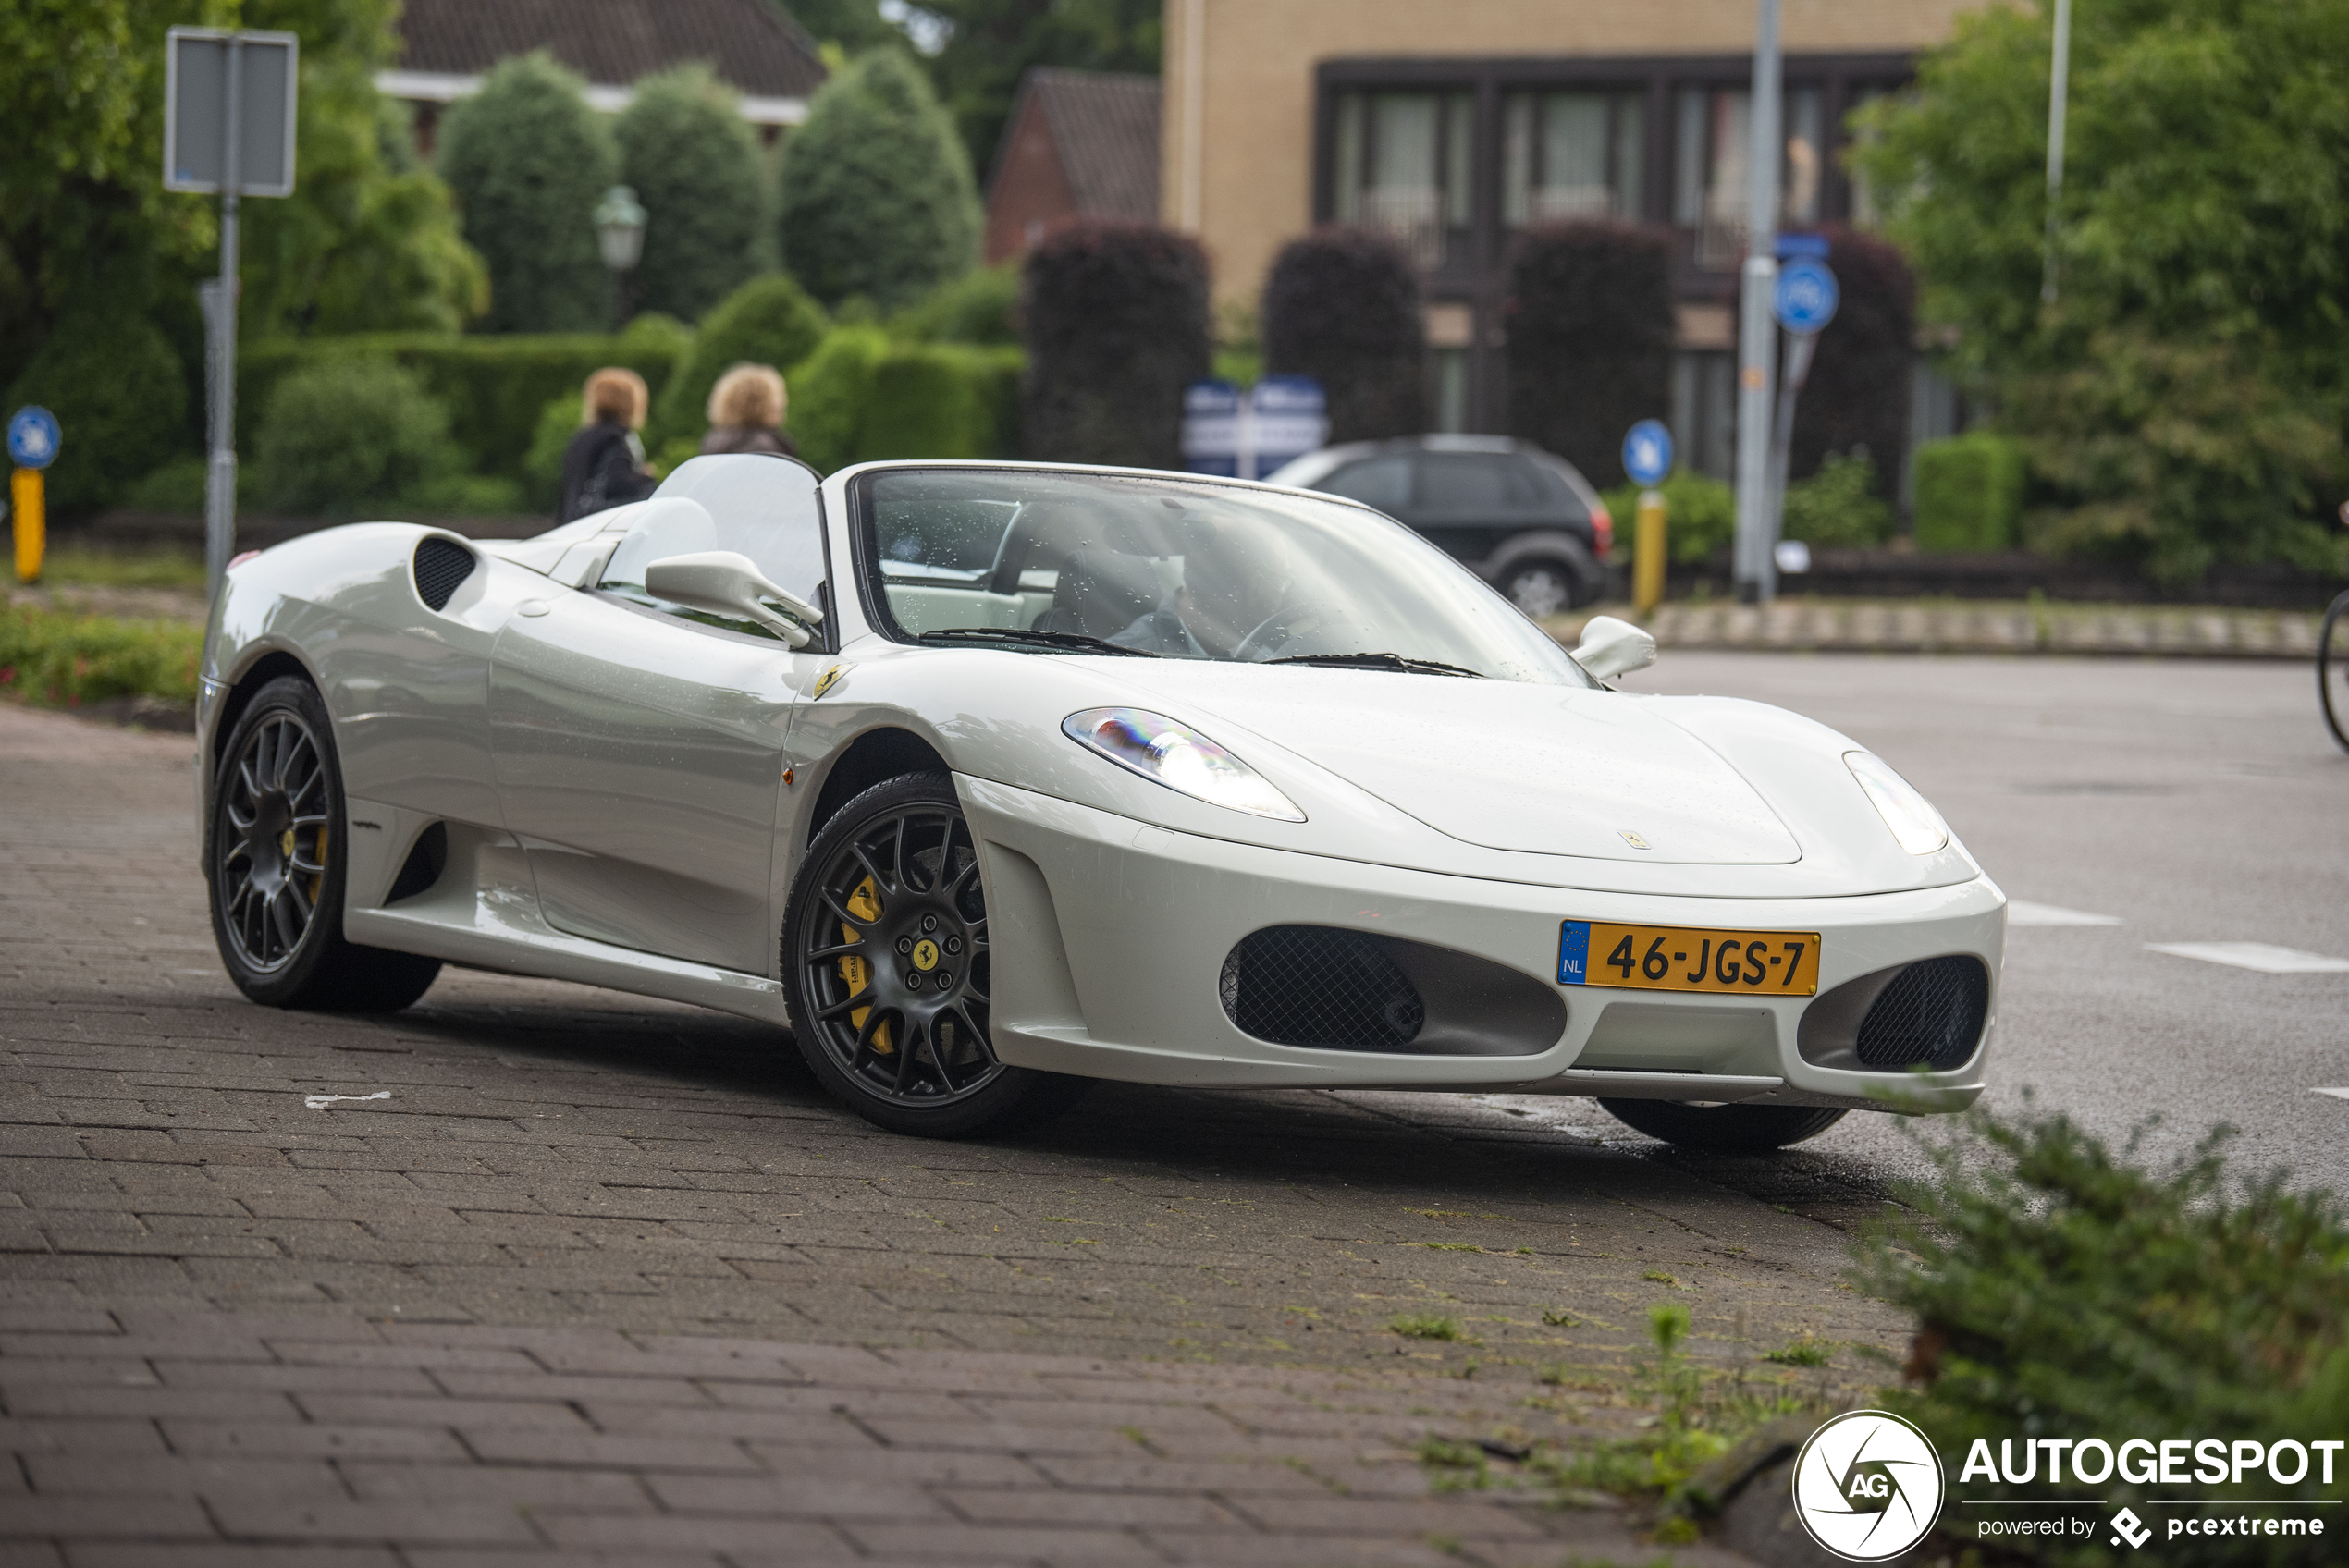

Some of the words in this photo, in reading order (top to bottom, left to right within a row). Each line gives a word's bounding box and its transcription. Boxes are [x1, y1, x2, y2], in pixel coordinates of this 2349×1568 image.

[850, 956, 858, 984] rrari
[1564, 959, 1582, 974] NL
[1607, 935, 1805, 986] 46-JGS-7
